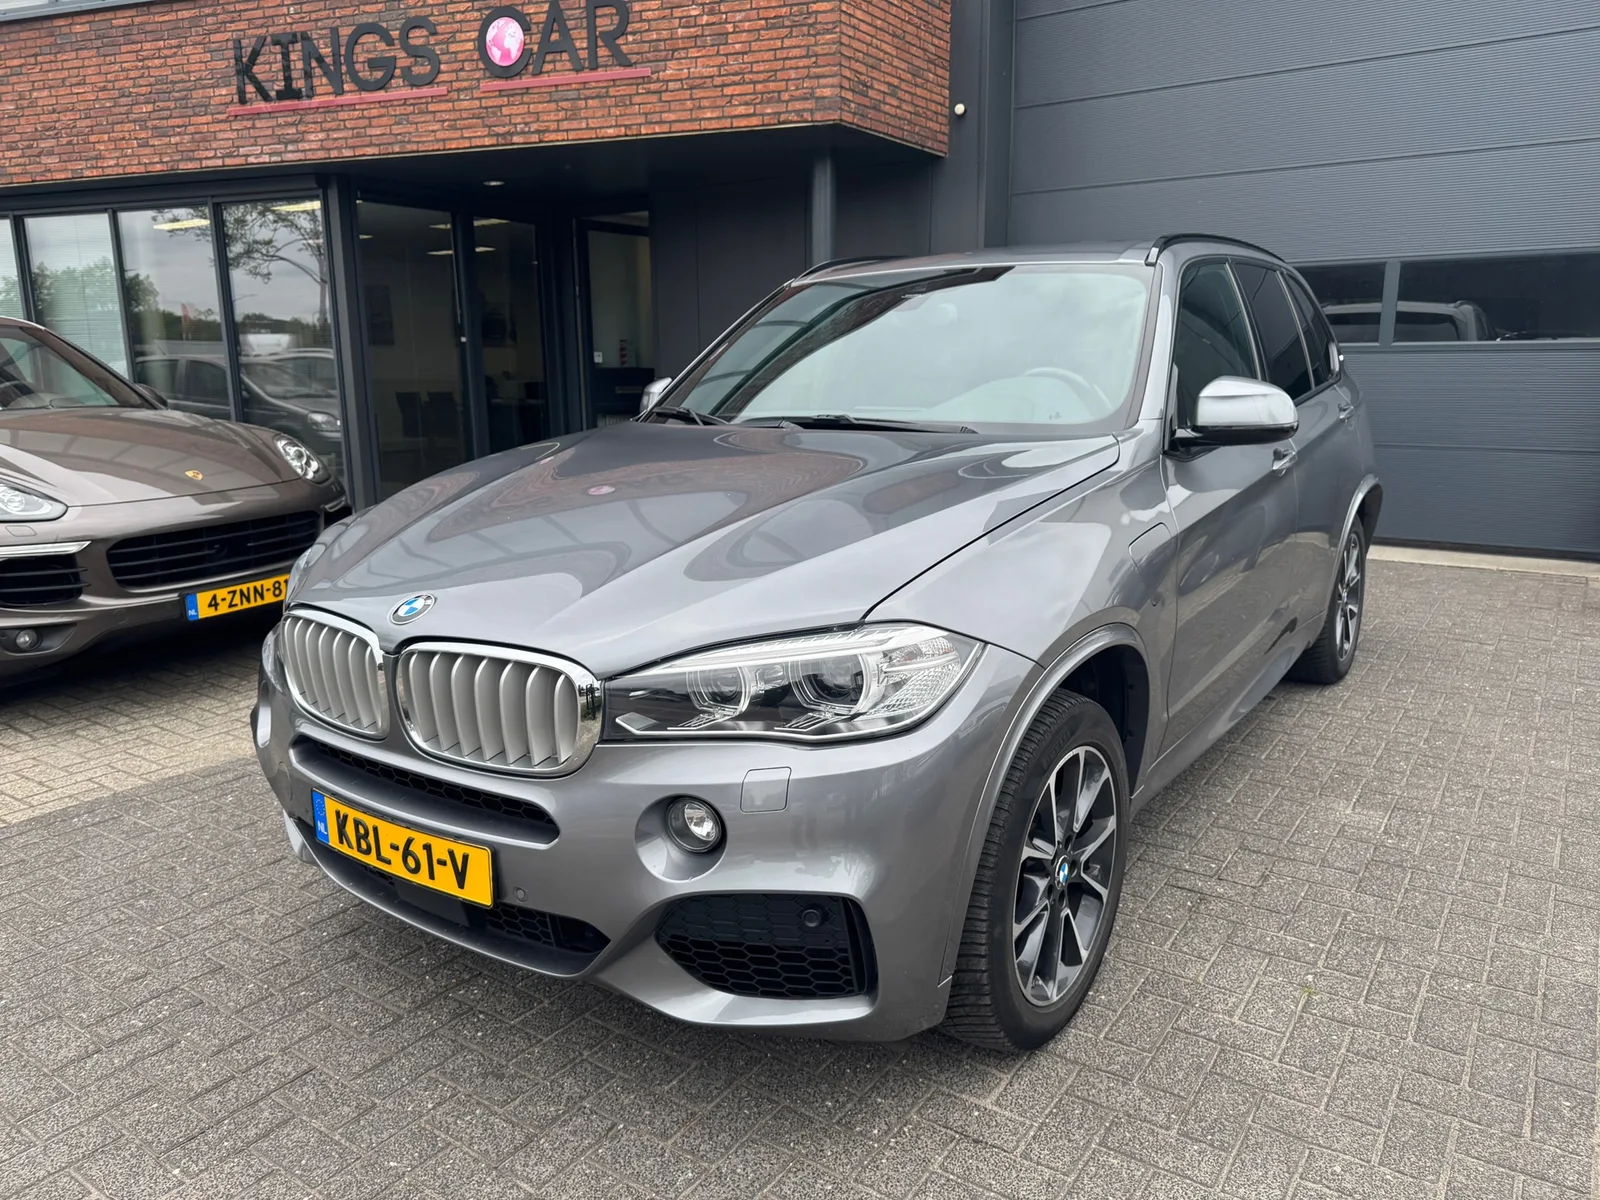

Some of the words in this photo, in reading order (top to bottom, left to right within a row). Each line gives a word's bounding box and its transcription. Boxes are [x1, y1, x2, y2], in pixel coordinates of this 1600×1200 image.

[233, 16, 440, 105] KINGS
[478, 0, 633, 78] CAR
[317, 821, 328, 835] NL
[335, 809, 470, 890] KBL-61-V
